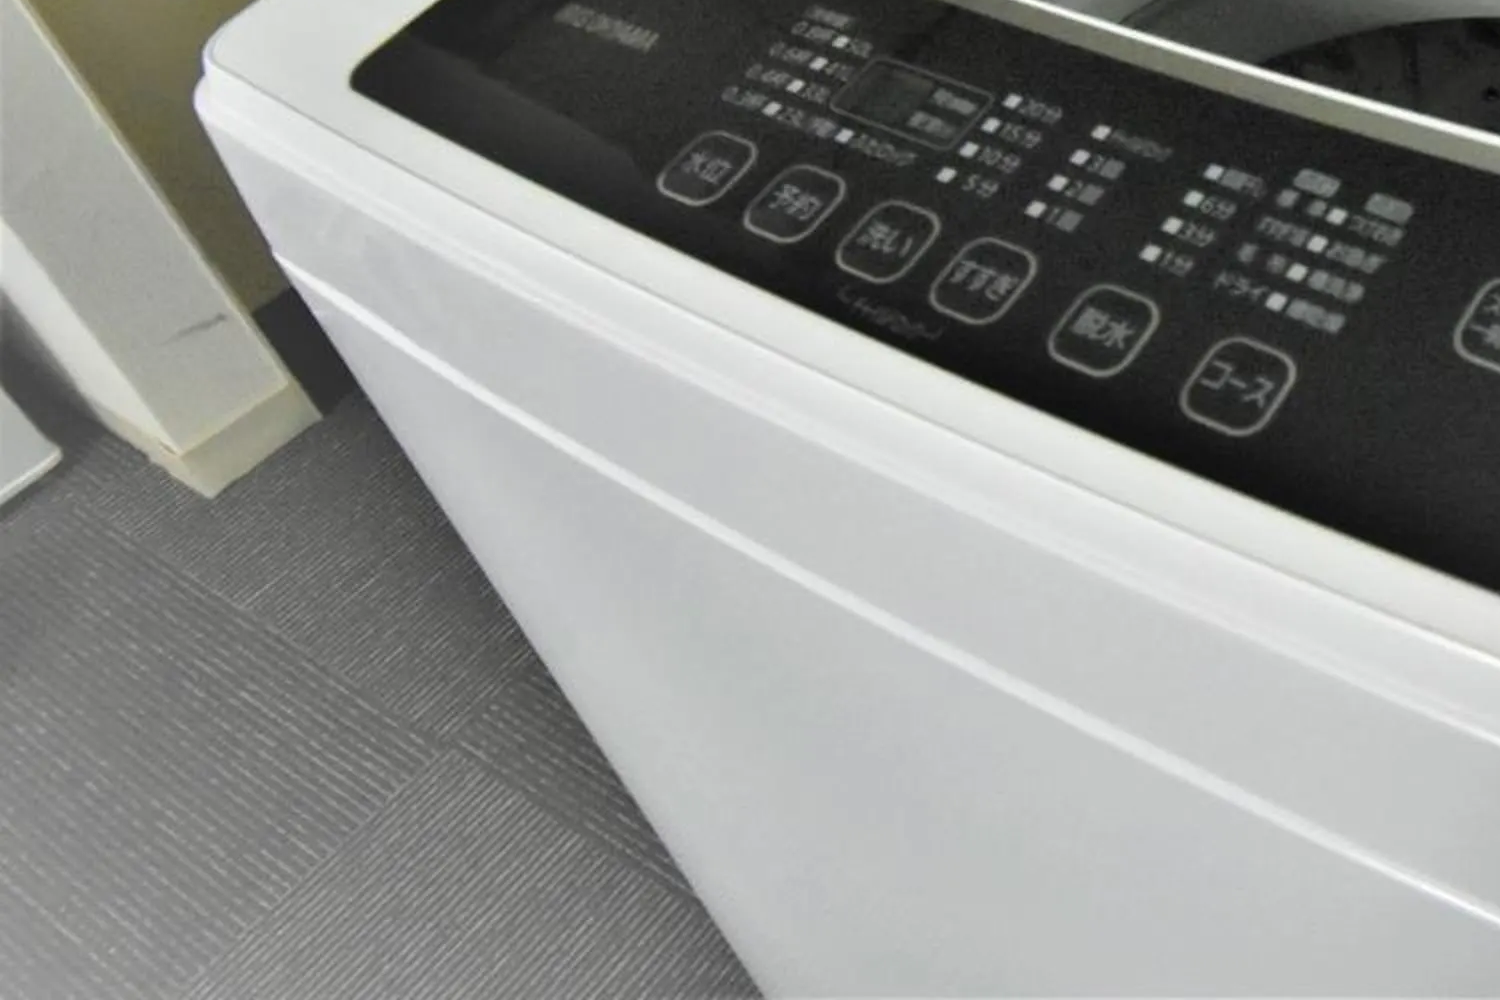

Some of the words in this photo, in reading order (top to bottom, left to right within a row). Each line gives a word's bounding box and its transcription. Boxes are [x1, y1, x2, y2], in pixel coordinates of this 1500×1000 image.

[768, 183, 824, 221] 予約
[855, 218, 914, 259] 洗い
[948, 260, 1021, 302] すすぎ
[1200, 359, 1275, 408] コース
